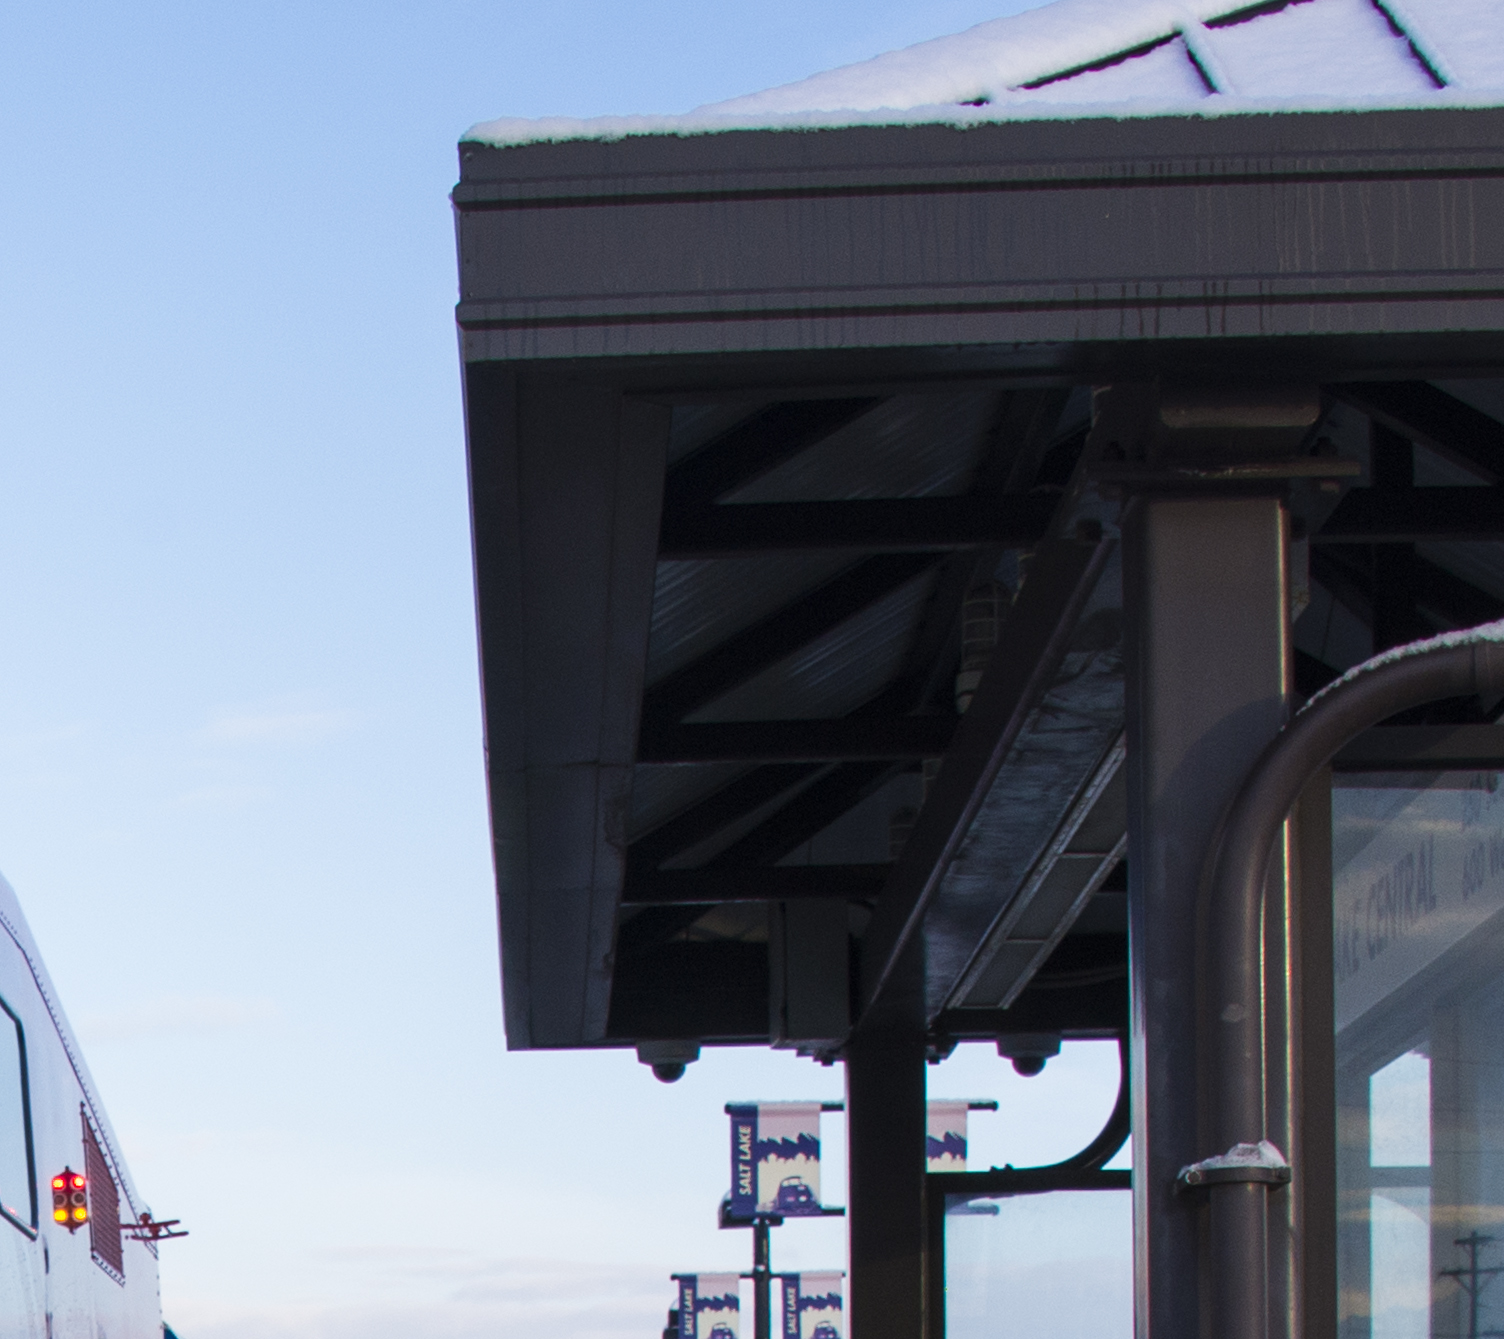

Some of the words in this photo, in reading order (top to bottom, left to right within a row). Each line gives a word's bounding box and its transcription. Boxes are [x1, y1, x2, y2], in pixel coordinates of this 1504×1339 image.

[1366, 832, 1437, 961] CENTRAL
[739, 1125, 752, 1160] LAKE
[739, 1162, 752, 1197] SALT
